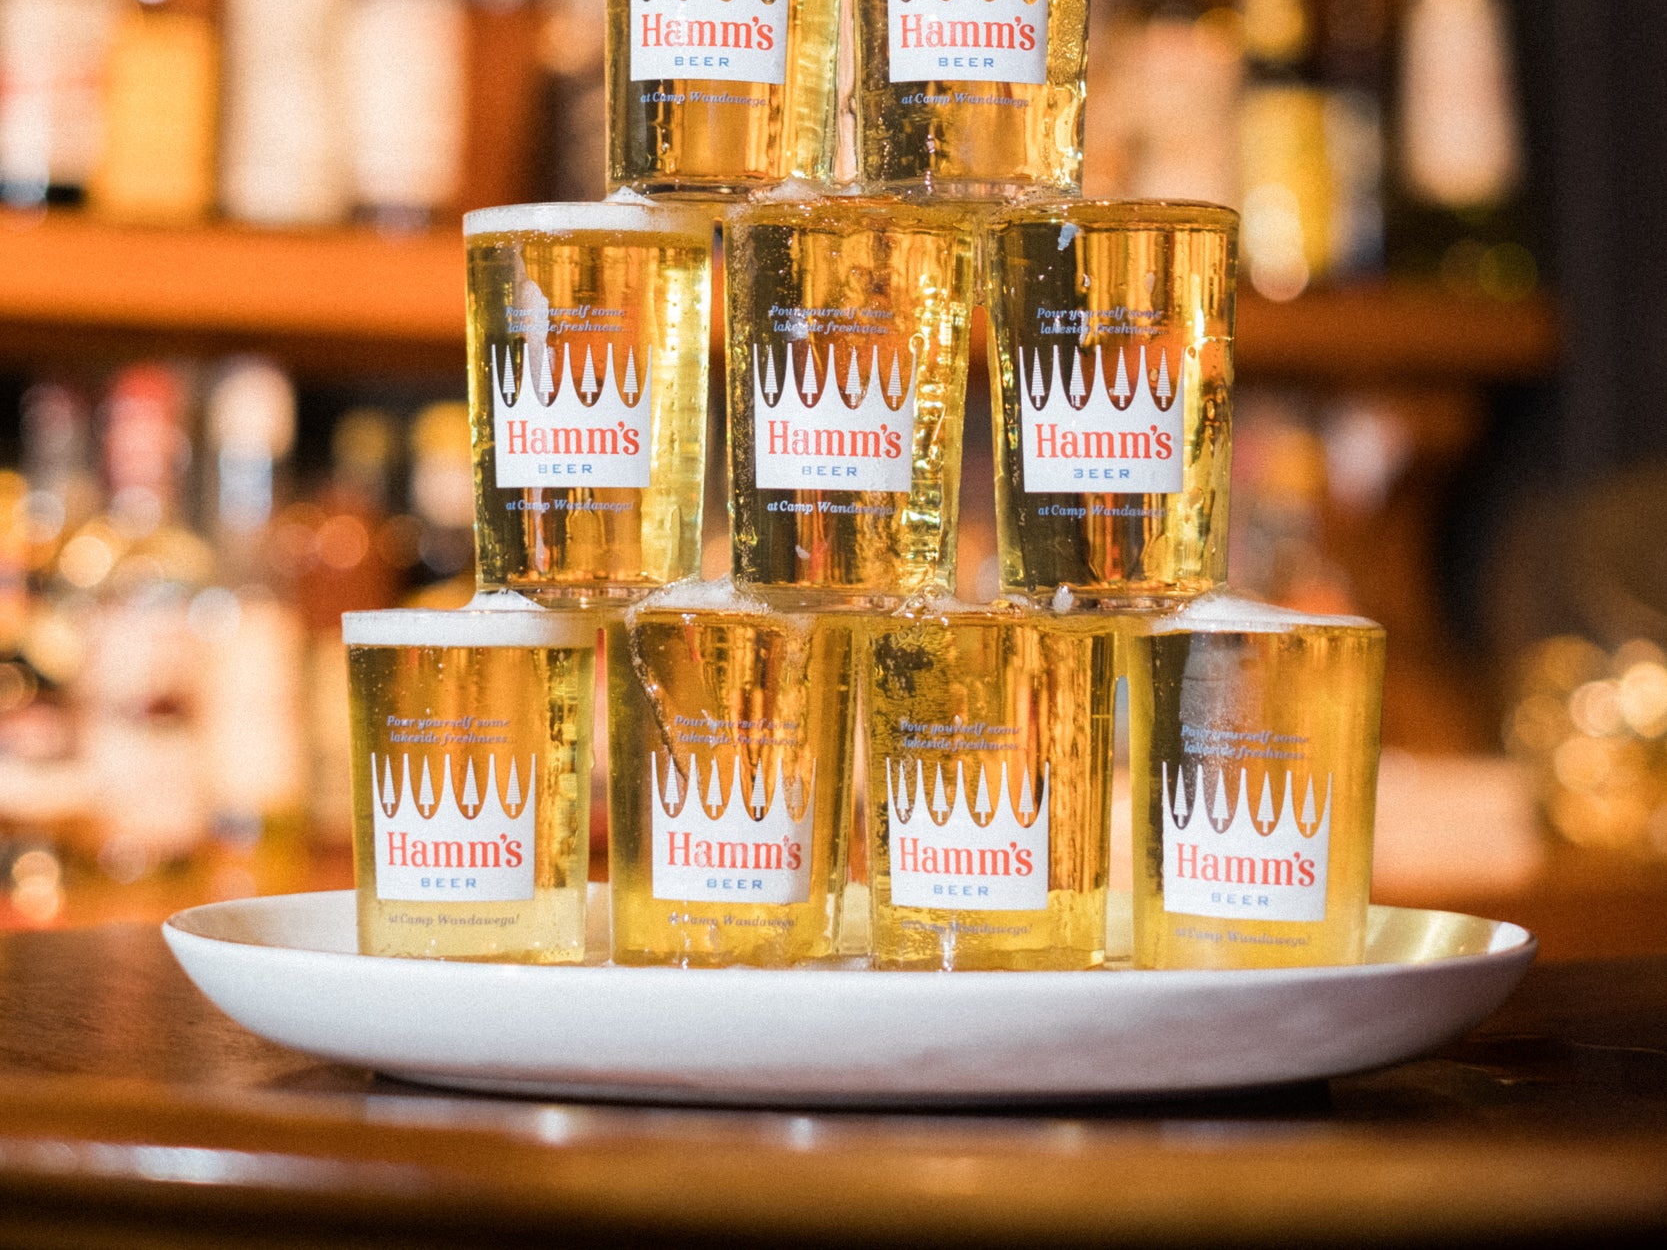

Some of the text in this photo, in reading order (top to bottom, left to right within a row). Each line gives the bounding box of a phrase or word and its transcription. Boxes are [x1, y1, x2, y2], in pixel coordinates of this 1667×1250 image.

[642, 14, 774, 50] Hamm's
[901, 14, 1035, 50] Hamm's
[674, 55, 731, 68] BEER
[938, 55, 996, 69] BEER
[640, 93, 650, 103] at
[652, 91, 685, 104] Camp
[901, 94, 912, 104] at
[914, 93, 950, 105] Camp
[1037, 308, 1066, 318] Pour
[508, 420, 639, 455] Hamm's
[769, 420, 901, 458] Hamm's
[1035, 424, 1172, 460] Hamm's
[537, 462, 593, 476] BEER
[802, 464, 858, 478] BEER
[1072, 467, 1132, 482] BEER
[506, 500, 516, 510] at
[767, 502, 778, 511] at
[779, 500, 813, 514] Camp
[1038, 507, 1049, 515] at
[1051, 505, 1086, 519] Camp
[387, 715, 415, 726] Pour
[418, 716, 473, 730] yourself
[388, 832, 522, 868] Hamm's
[668, 832, 803, 871] Hamm's
[900, 837, 1033, 876] Hamm's
[1178, 844, 1315, 886] Hamm's
[420, 877, 477, 890] BEER
[705, 878, 764, 890] BEER
[932, 884, 991, 897] BEER
[1211, 892, 1270, 907] BEER
